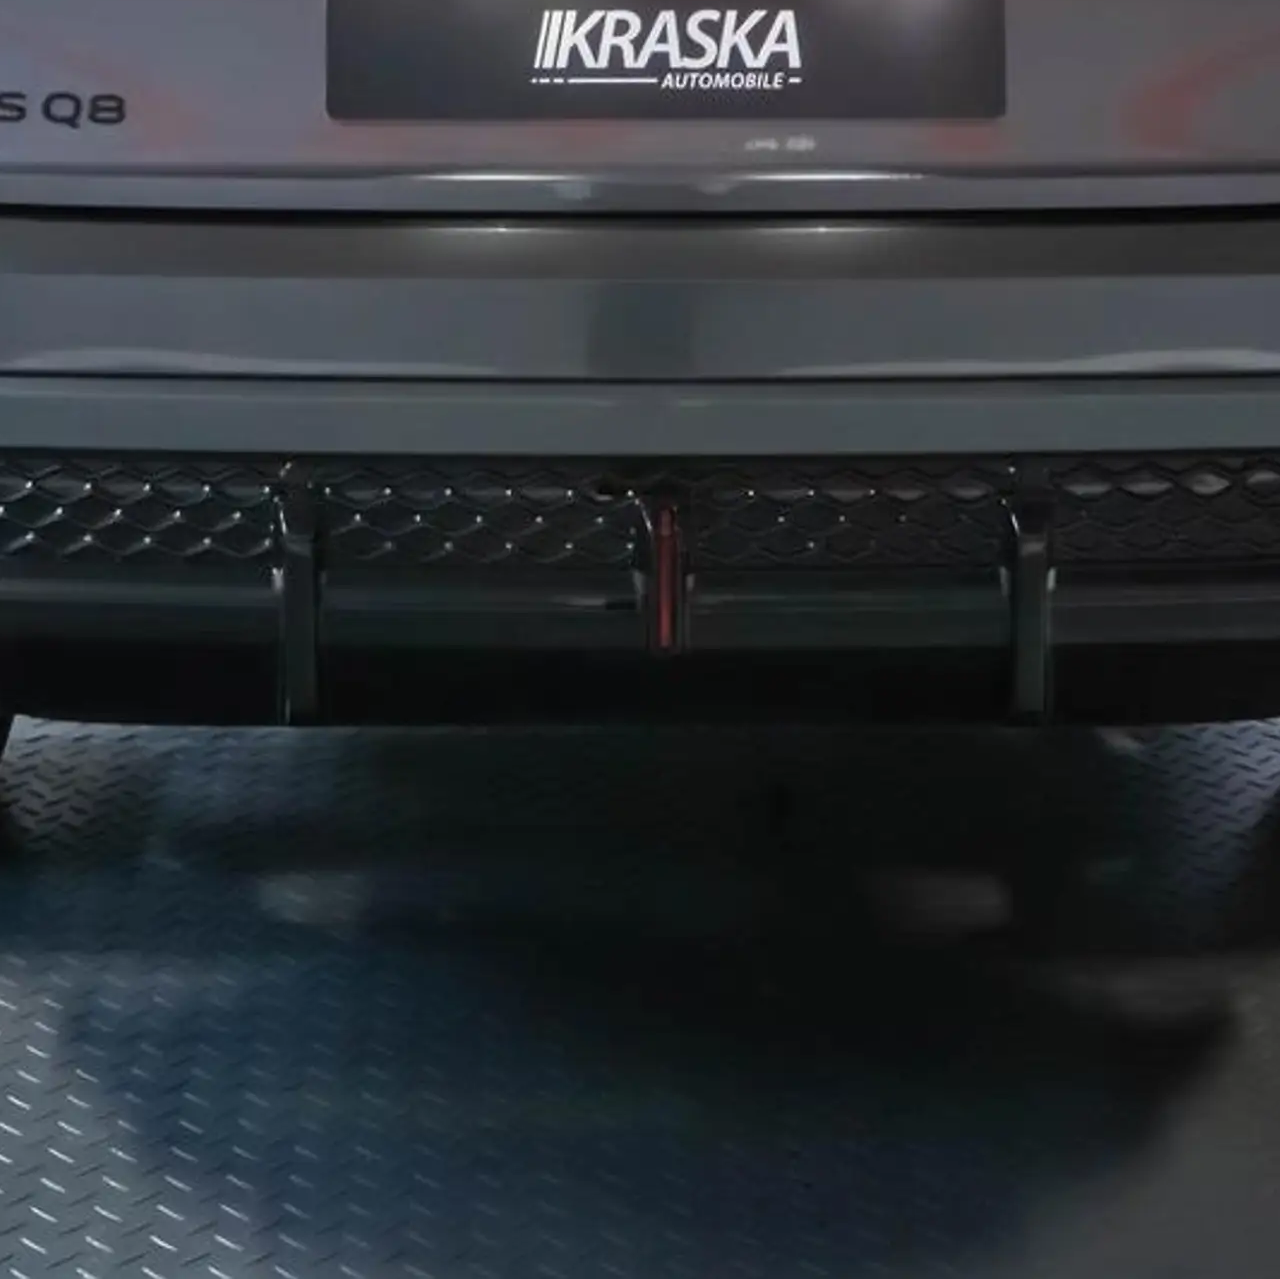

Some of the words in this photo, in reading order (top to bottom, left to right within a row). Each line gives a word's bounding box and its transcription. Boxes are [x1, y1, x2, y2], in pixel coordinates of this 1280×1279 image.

[558, 8, 803, 69] KRASKA
[660, 72, 785, 91] AUTOMOBILE
[41, 92, 127, 129] Q8
